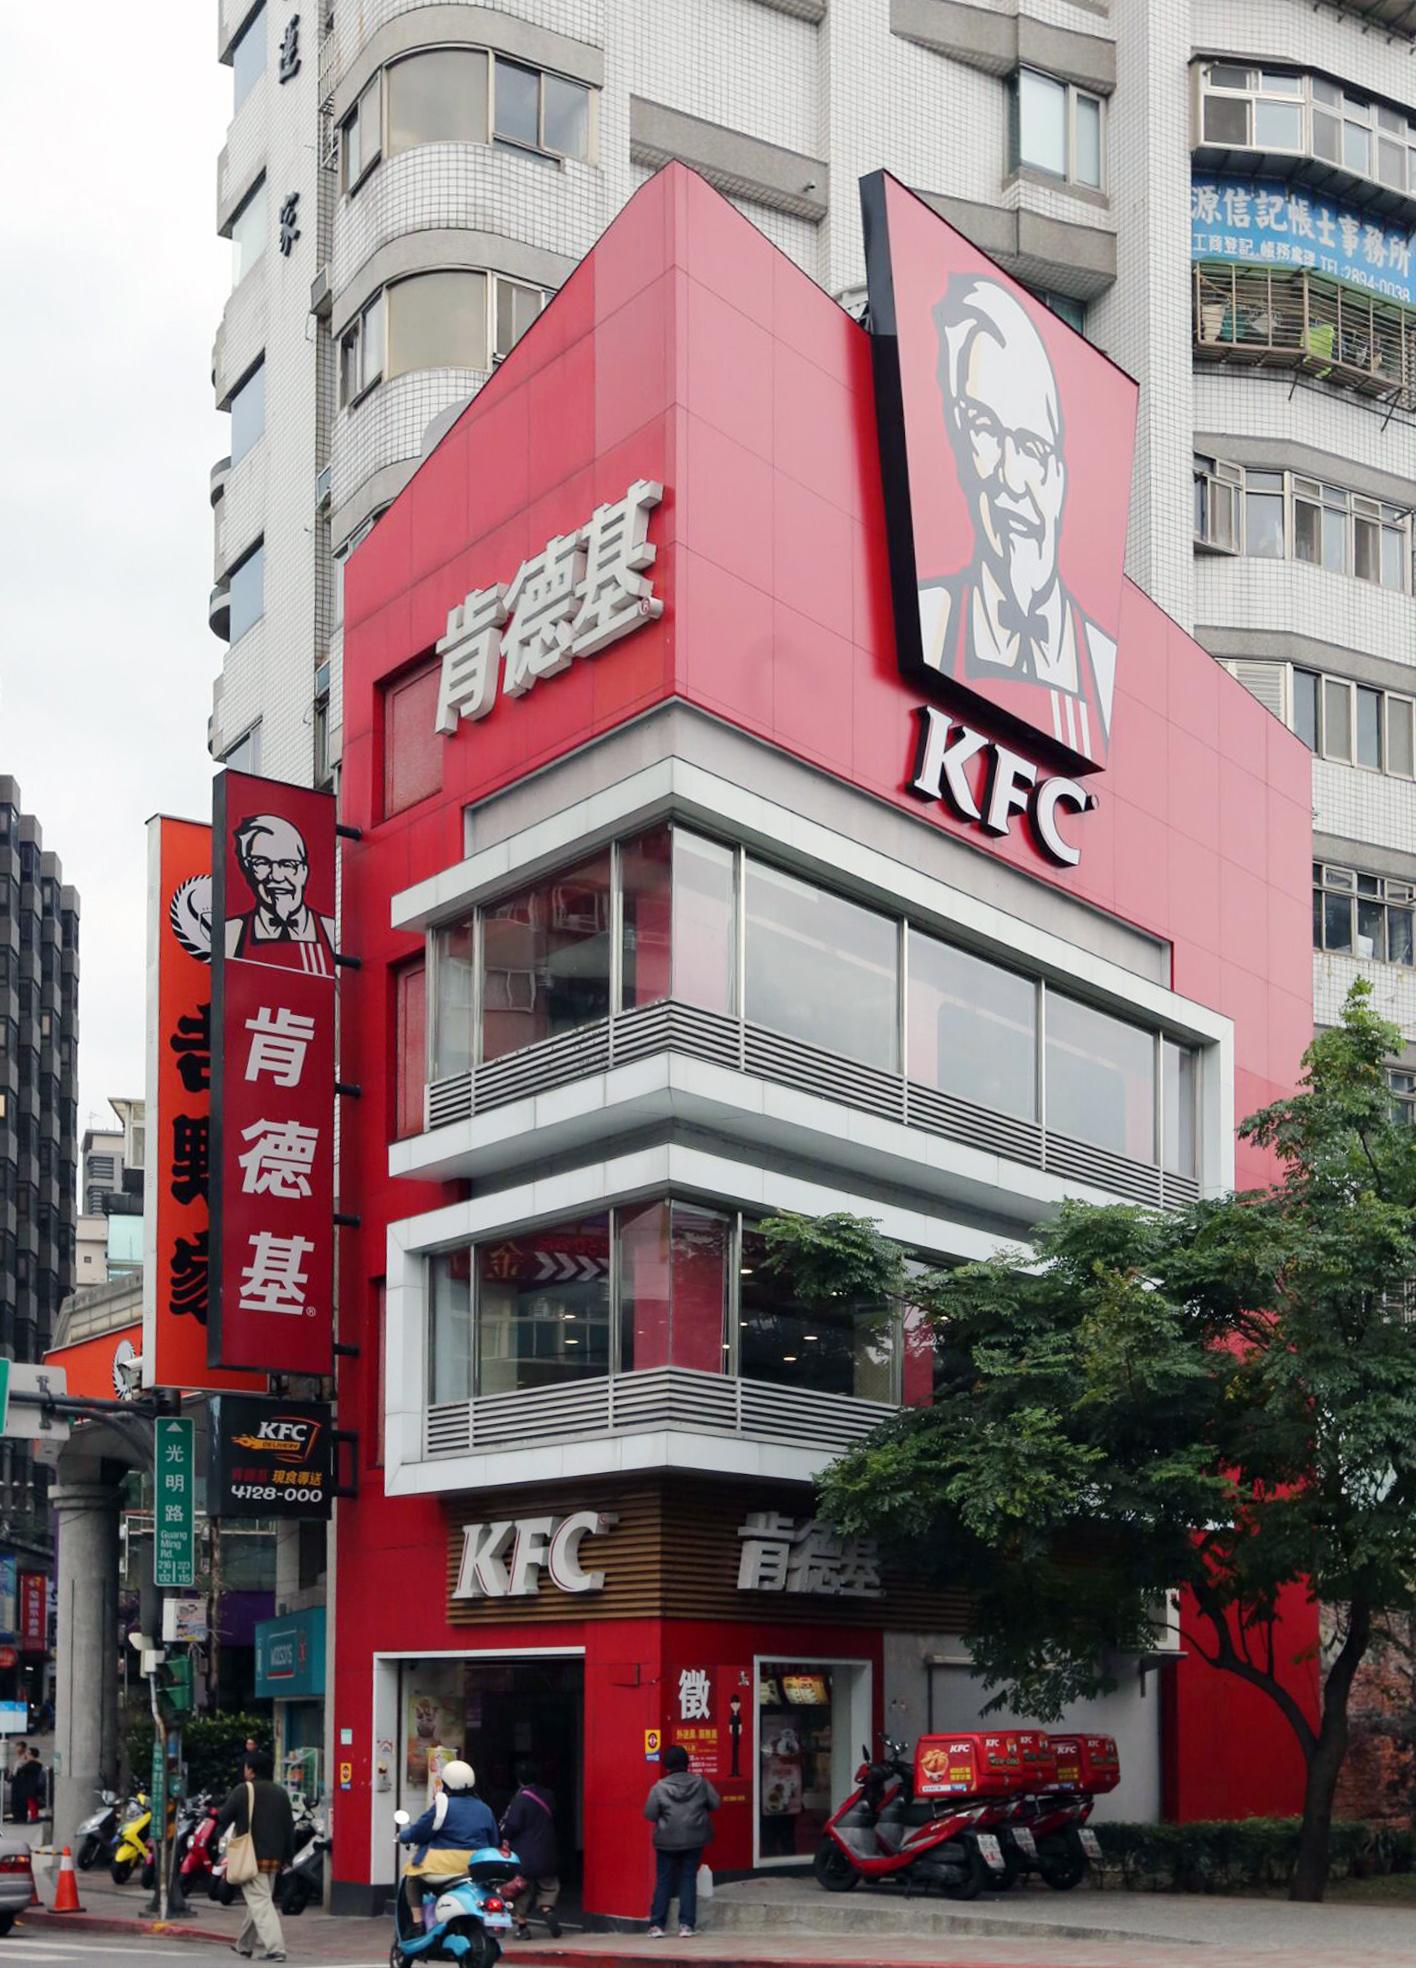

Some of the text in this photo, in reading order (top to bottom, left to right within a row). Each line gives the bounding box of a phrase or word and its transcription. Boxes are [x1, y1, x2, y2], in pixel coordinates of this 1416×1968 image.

[1191, 185, 1411, 277] 源信記帳士事務所
[434, 479, 664, 734] 肯德基
[912, 705, 1099, 868] KFC
[238, 1006, 319, 1316] 肯德基
[257, 1422, 307, 1441] KFC
[165, 1444, 184, 1522] 光明路
[231, 1485, 323, 1502] 4128-000
[160, 1530, 188, 1540] Guang
[160, 1540, 182, 1550] Ming
[160, 1549, 174, 1558] Rd.
[452, 1511, 620, 1599] KFC
[678, 1668, 711, 1720] 徵
[949, 1744, 970, 1753] KFC
[1057, 1745, 1077, 1754] KFC
